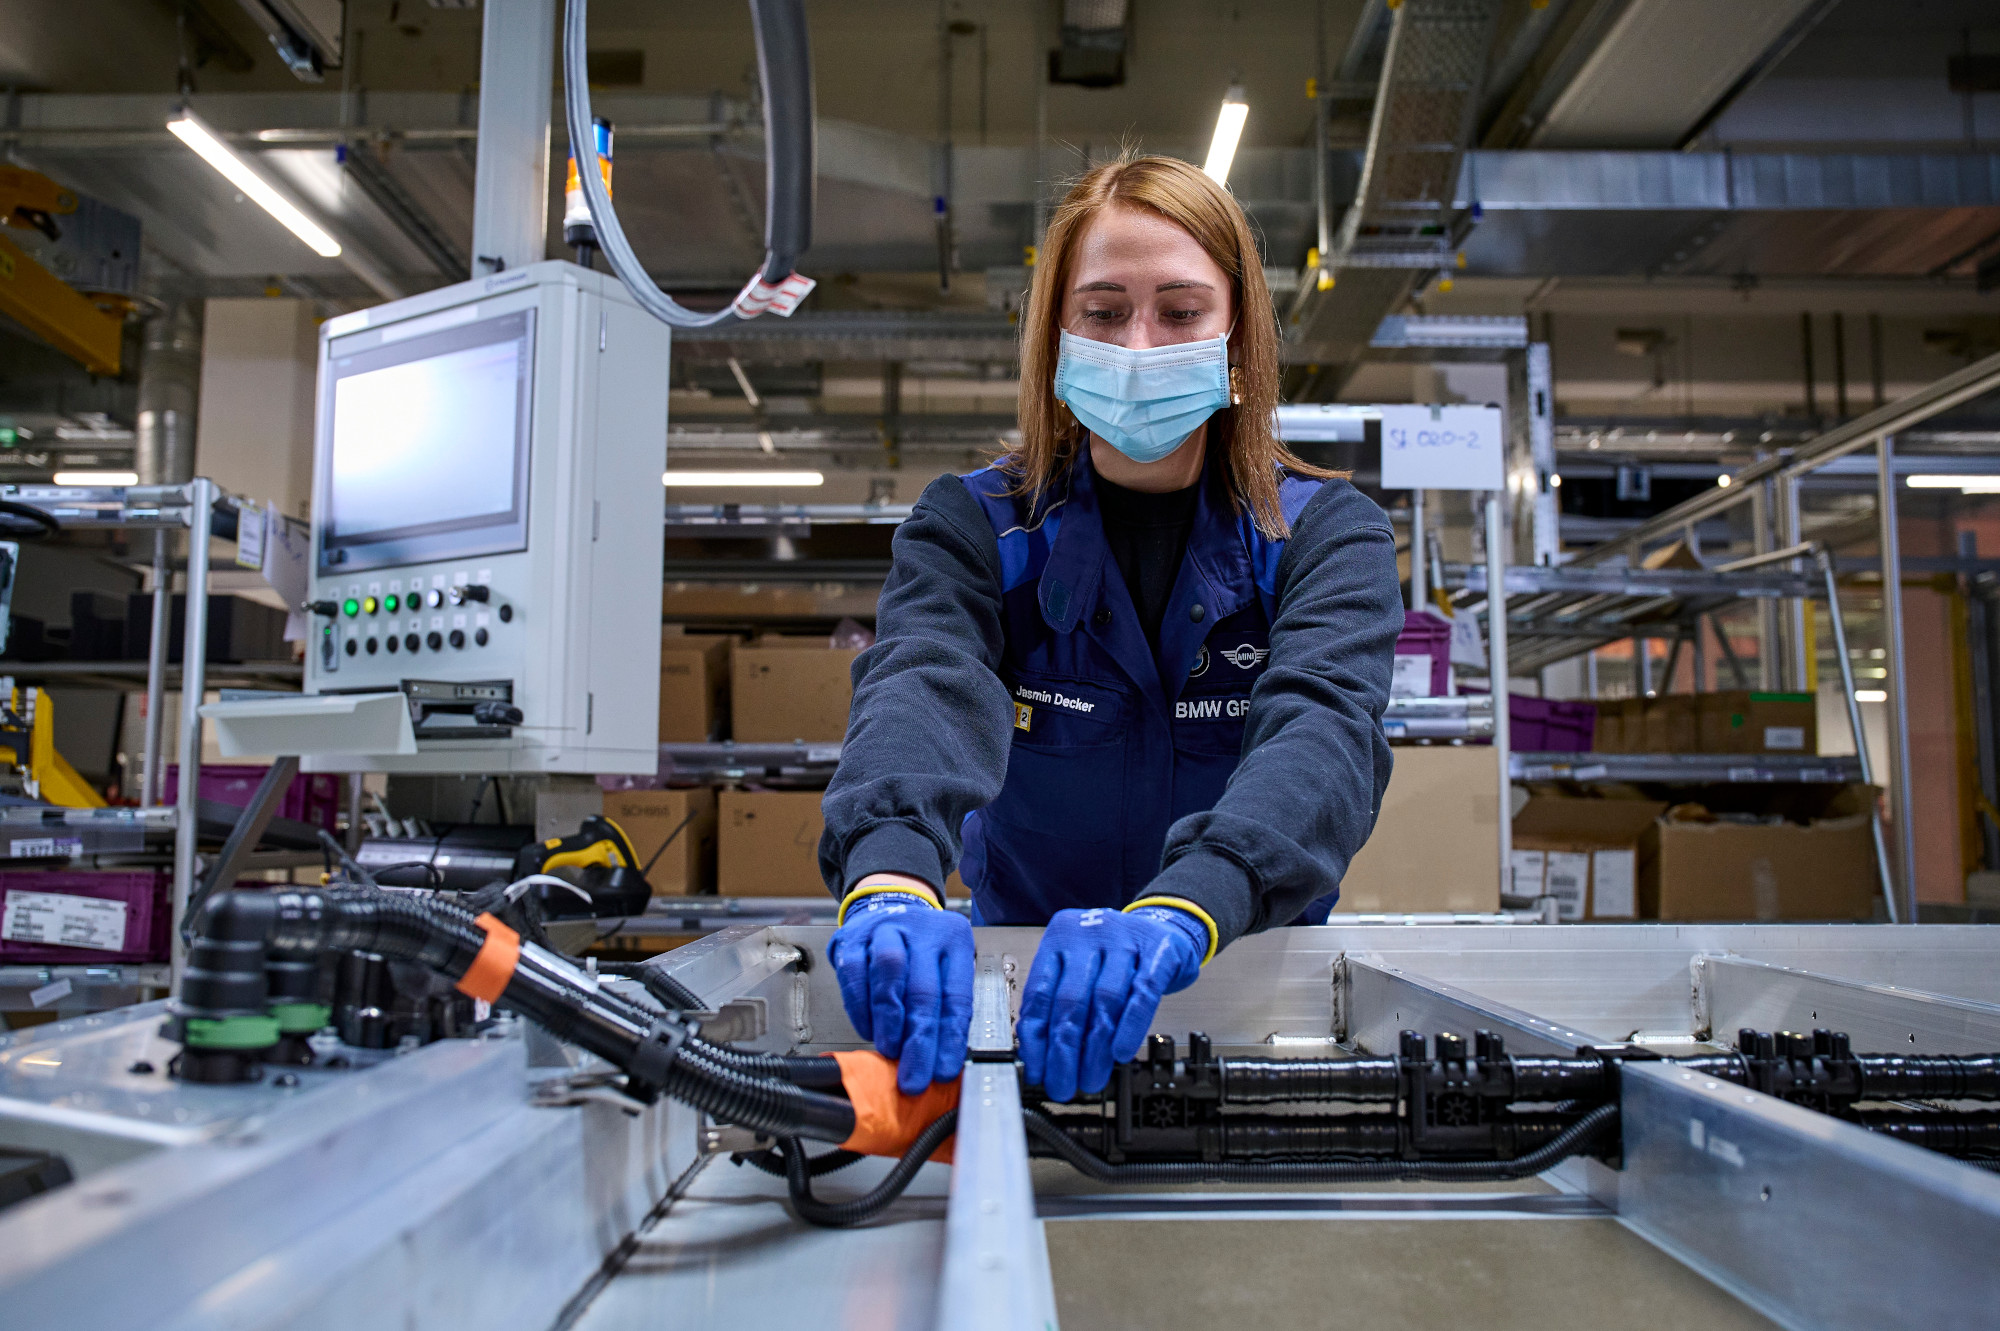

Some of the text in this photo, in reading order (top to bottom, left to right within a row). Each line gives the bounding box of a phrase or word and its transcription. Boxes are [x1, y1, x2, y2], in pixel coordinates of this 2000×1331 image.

[1417, 430, 1481, 449] 020-2
[1237, 652, 1254, 661] MINI
[1016, 685, 1095, 713] Jasmin Decker
[1021, 711, 1028, 723] 2
[1175, 700, 1222, 718] BMW
